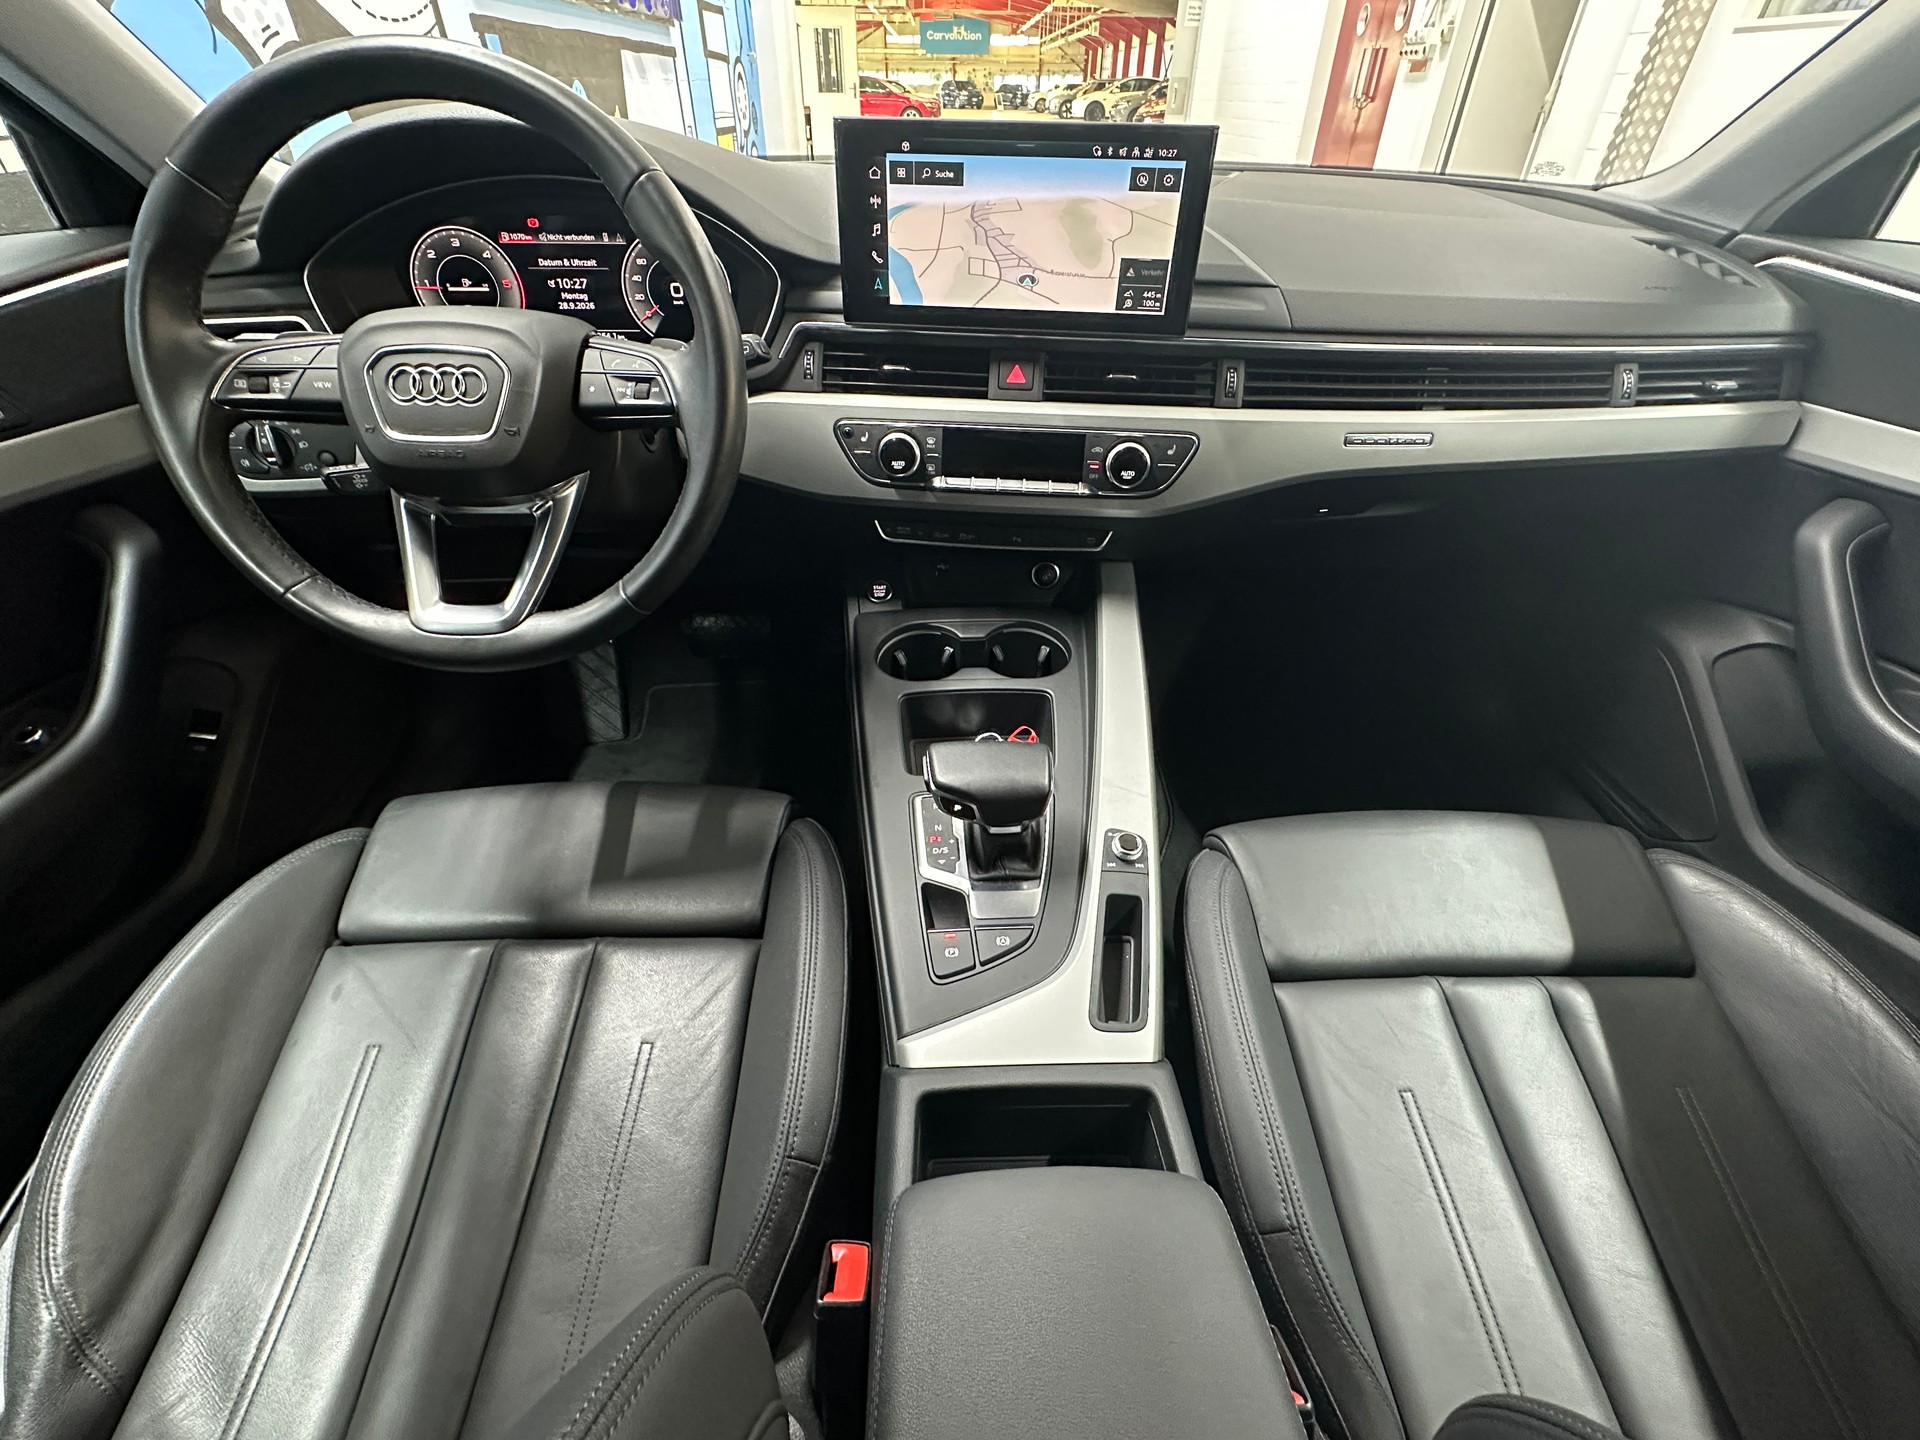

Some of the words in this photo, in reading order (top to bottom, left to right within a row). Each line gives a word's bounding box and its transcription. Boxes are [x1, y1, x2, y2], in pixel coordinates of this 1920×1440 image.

[926, 29, 982, 41] Carvolution
[1158, 149, 1178, 157] 10:27
[935, 169, 955, 178] Suche
[547, 233, 563, 241] Nicht
[564, 234, 596, 242] verbunden
[450, 238, 461, 247] 3
[426, 250, 437, 259] 2
[482, 250, 492, 259] 4
[538, 258, 563, 267] Datum
[563, 258, 570, 267] &
[571, 258, 597, 268] Uhrzeit
[635, 258, 648, 266] 60
[1141, 268, 1164, 277] Verkehr
[501, 279, 512, 288] 5
[556, 278, 588, 289] 10:27
[669, 282, 685, 298] 0
[561, 291, 588, 301] Montag
[634, 293, 645, 301] 20
[1142, 291, 1156, 299] 445
[558, 301, 596, 310] 28.9.2026
[1142, 299, 1155, 307] 100
[313, 381, 332, 389] VIEW
[1120, 470, 1136, 478] AUTO
[934, 824, 942, 832] N
[932, 847, 949, 855] D/S
